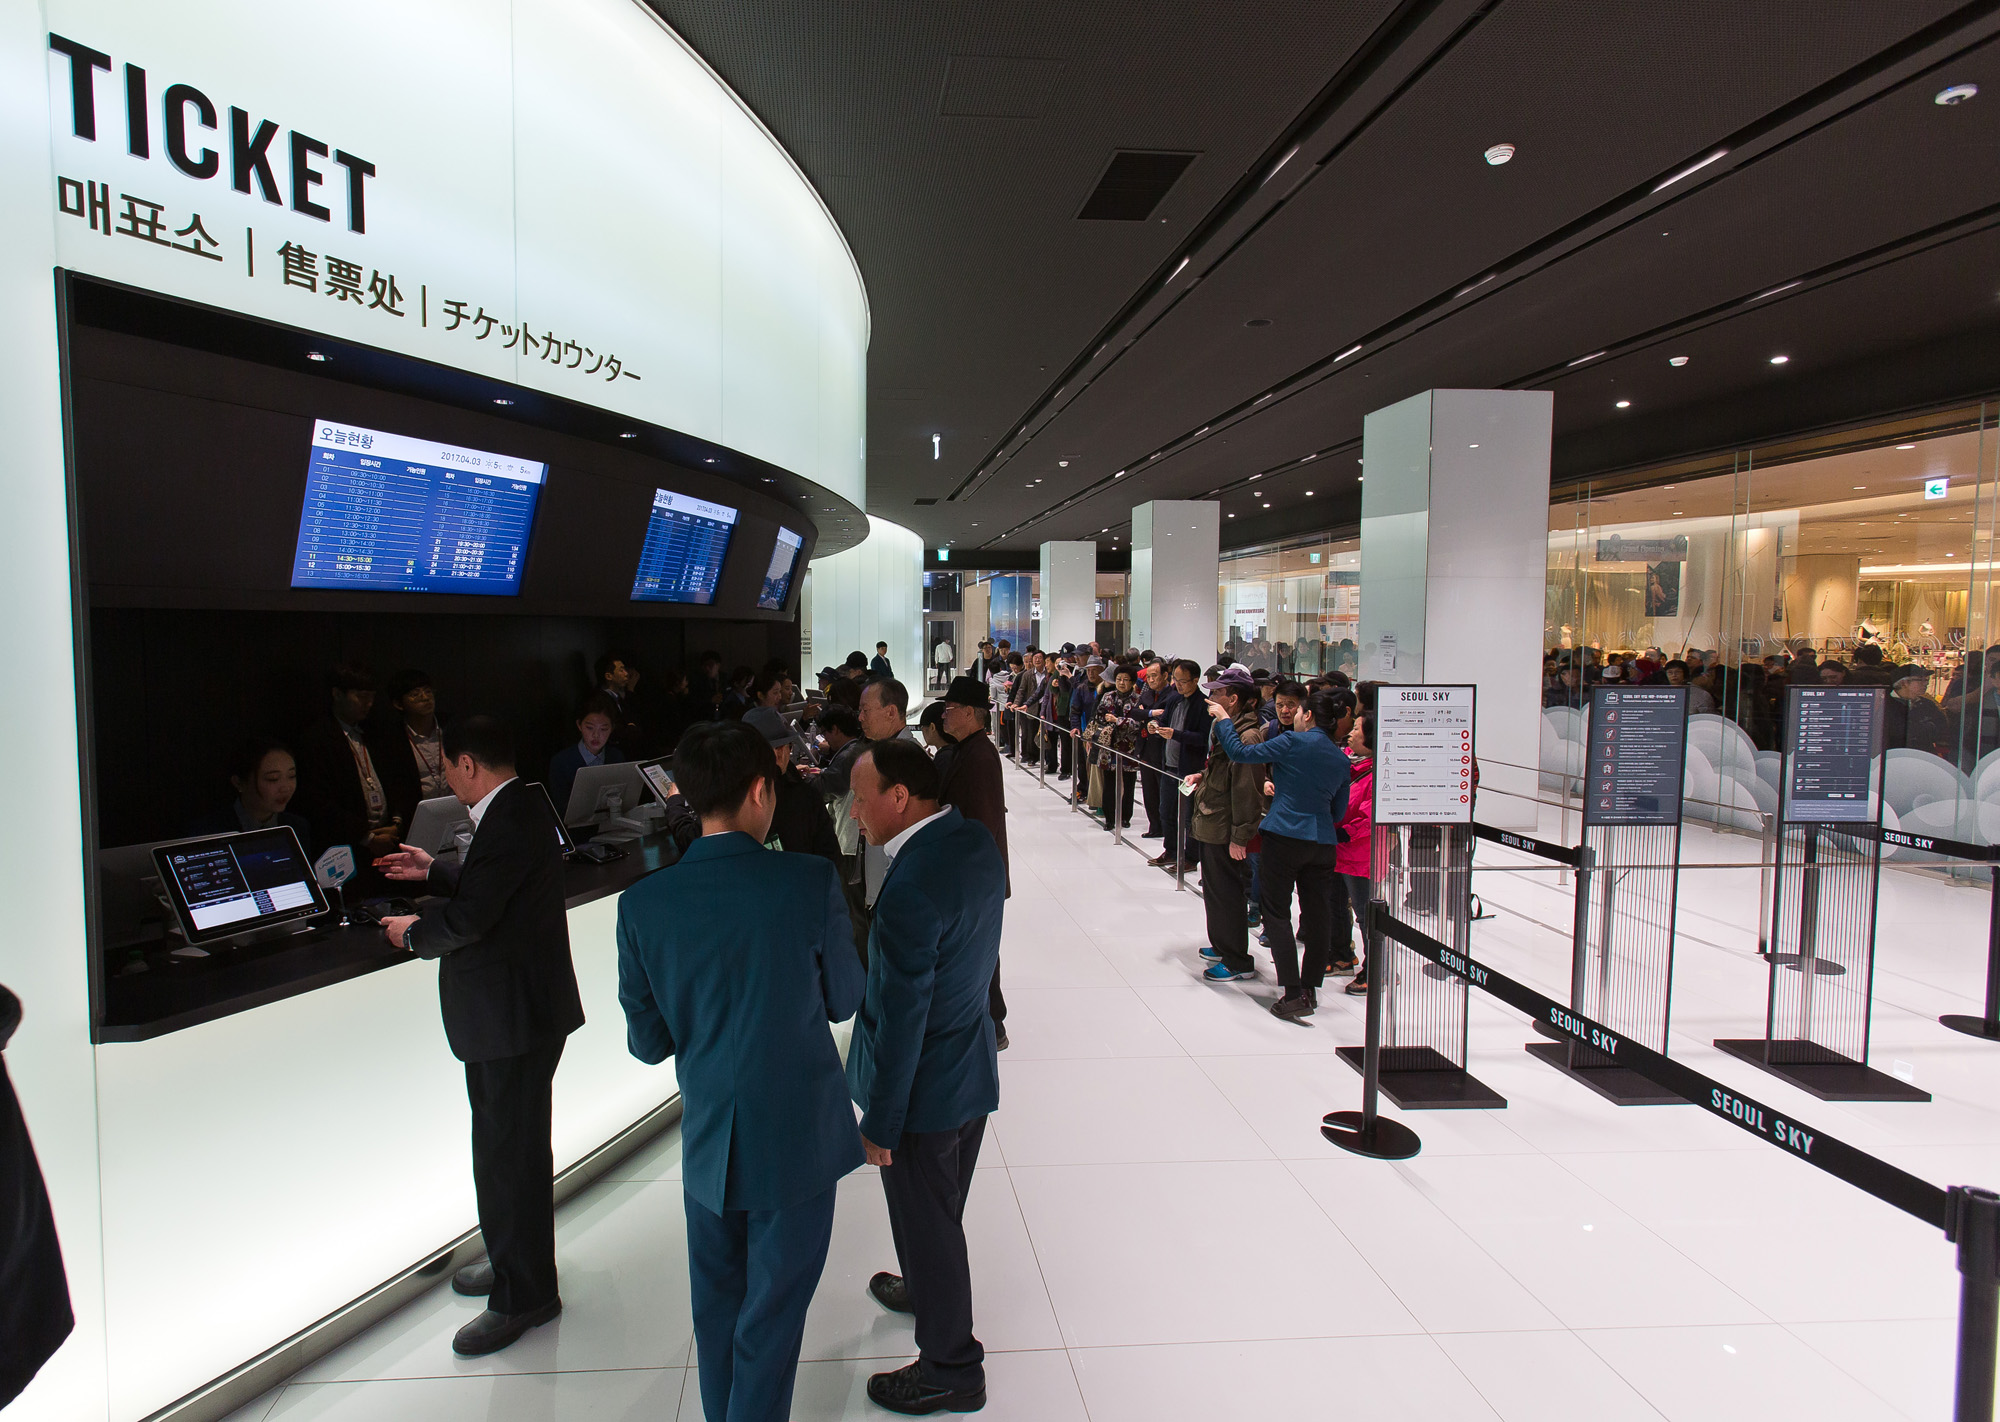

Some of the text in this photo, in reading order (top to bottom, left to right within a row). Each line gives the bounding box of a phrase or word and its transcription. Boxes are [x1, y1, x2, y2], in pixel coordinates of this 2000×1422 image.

[48, 31, 376, 236] TICKET
[57, 174, 224, 263] 매표소
[276, 238, 405, 318] 售票处
[441, 298, 642, 382] チケットカウンター
[320, 427, 374, 450] 오늘현황
[441, 451, 481, 466] 2017.04.03
[1401, 692, 1450, 701] SEOUL SKY
[1501, 833, 1536, 851] SEOUL SKY
[1884, 832, 1934, 849] SEOUL SKY
[1440, 949, 1489, 986] SEOUL SKY
[1550, 1007, 1618, 1055] SEOUL SKY
[1711, 1088, 1814, 1155] SEOUL SKY
